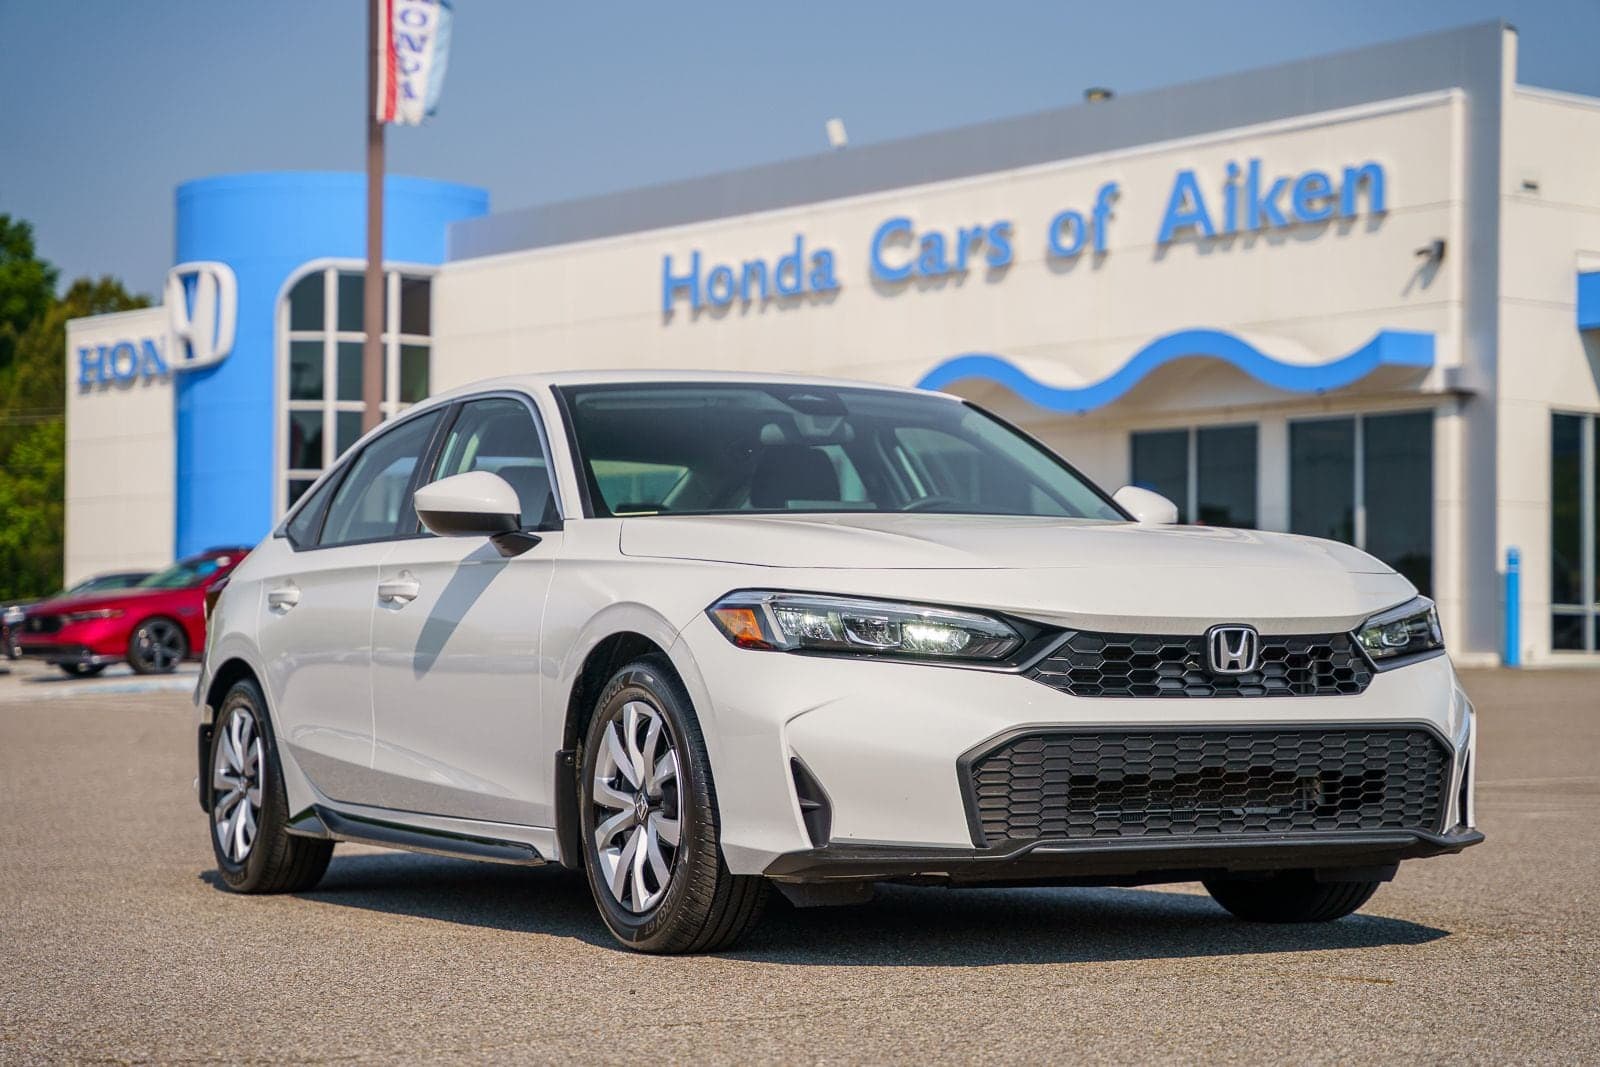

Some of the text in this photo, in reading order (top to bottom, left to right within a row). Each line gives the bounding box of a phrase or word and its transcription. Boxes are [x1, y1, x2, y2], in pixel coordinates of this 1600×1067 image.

[663, 158, 1387, 313] Honda Cars of Aiken
[1218, 628, 1250, 673] H
